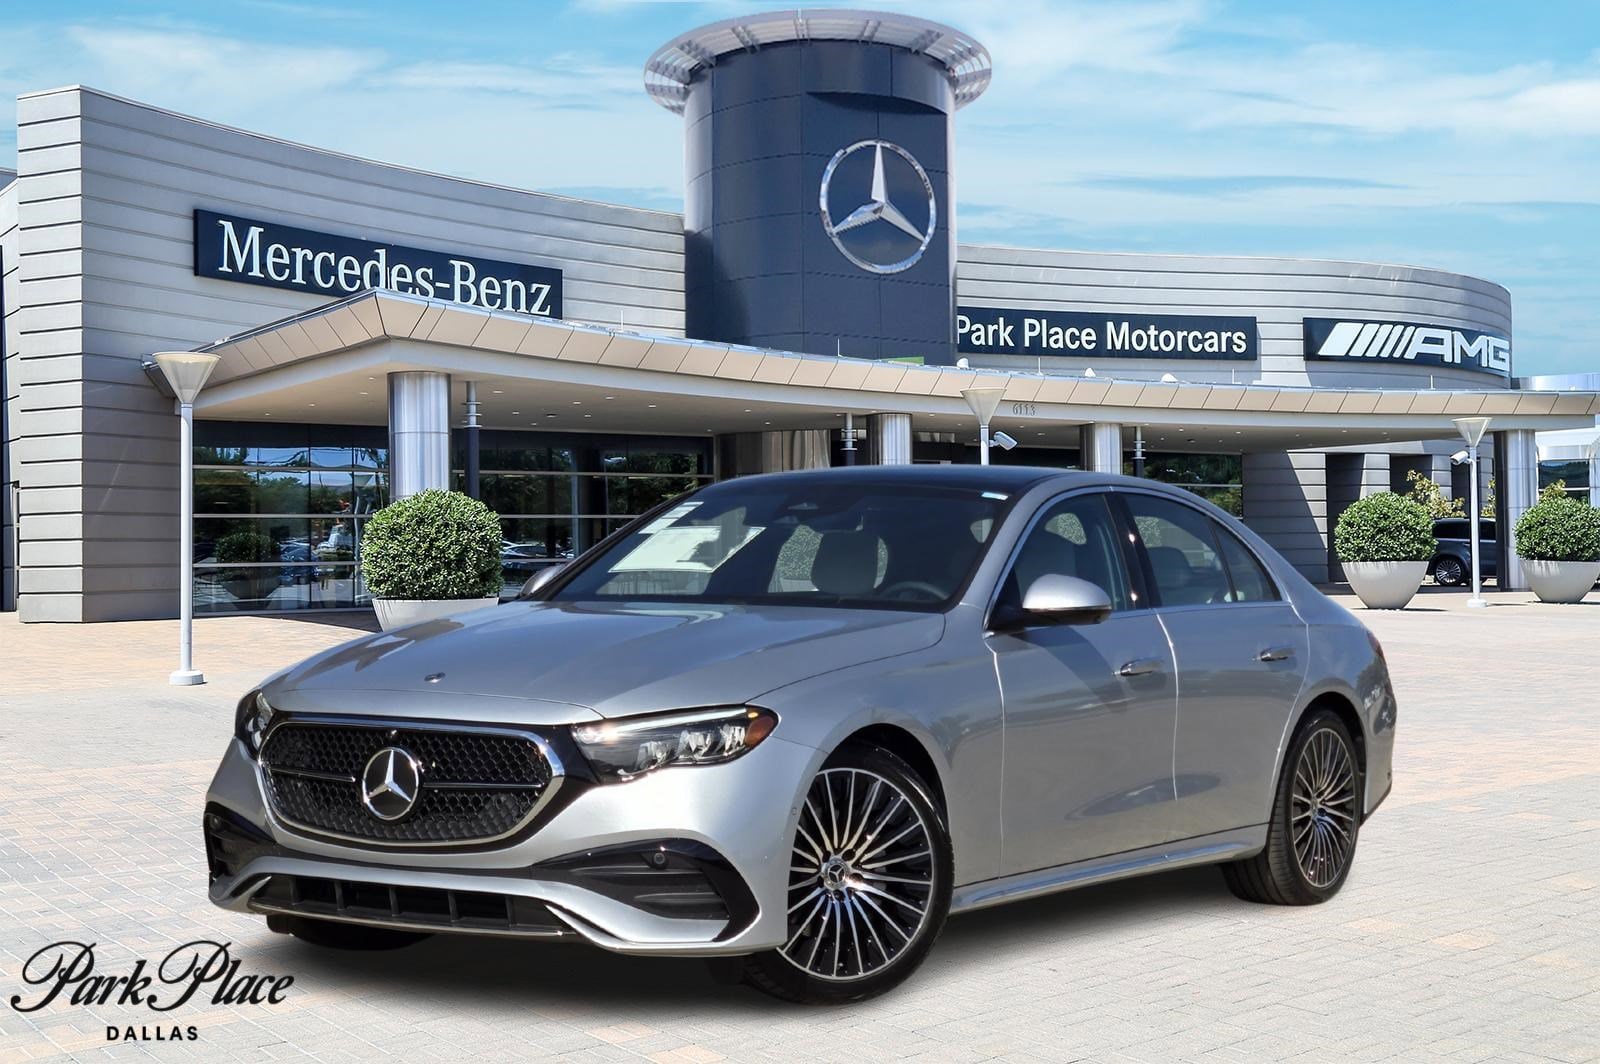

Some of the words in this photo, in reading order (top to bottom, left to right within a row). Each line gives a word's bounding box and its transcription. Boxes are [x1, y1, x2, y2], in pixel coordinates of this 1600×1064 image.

[217, 219, 552, 316] Mercedes-Benz
[957, 315, 1015, 347] Park
[1023, 318, 1097, 350] Place
[1106, 320, 1248, 353] Motorcars
[1403, 326, 1510, 371] AMG
[1012, 402, 1036, 416] 6113
